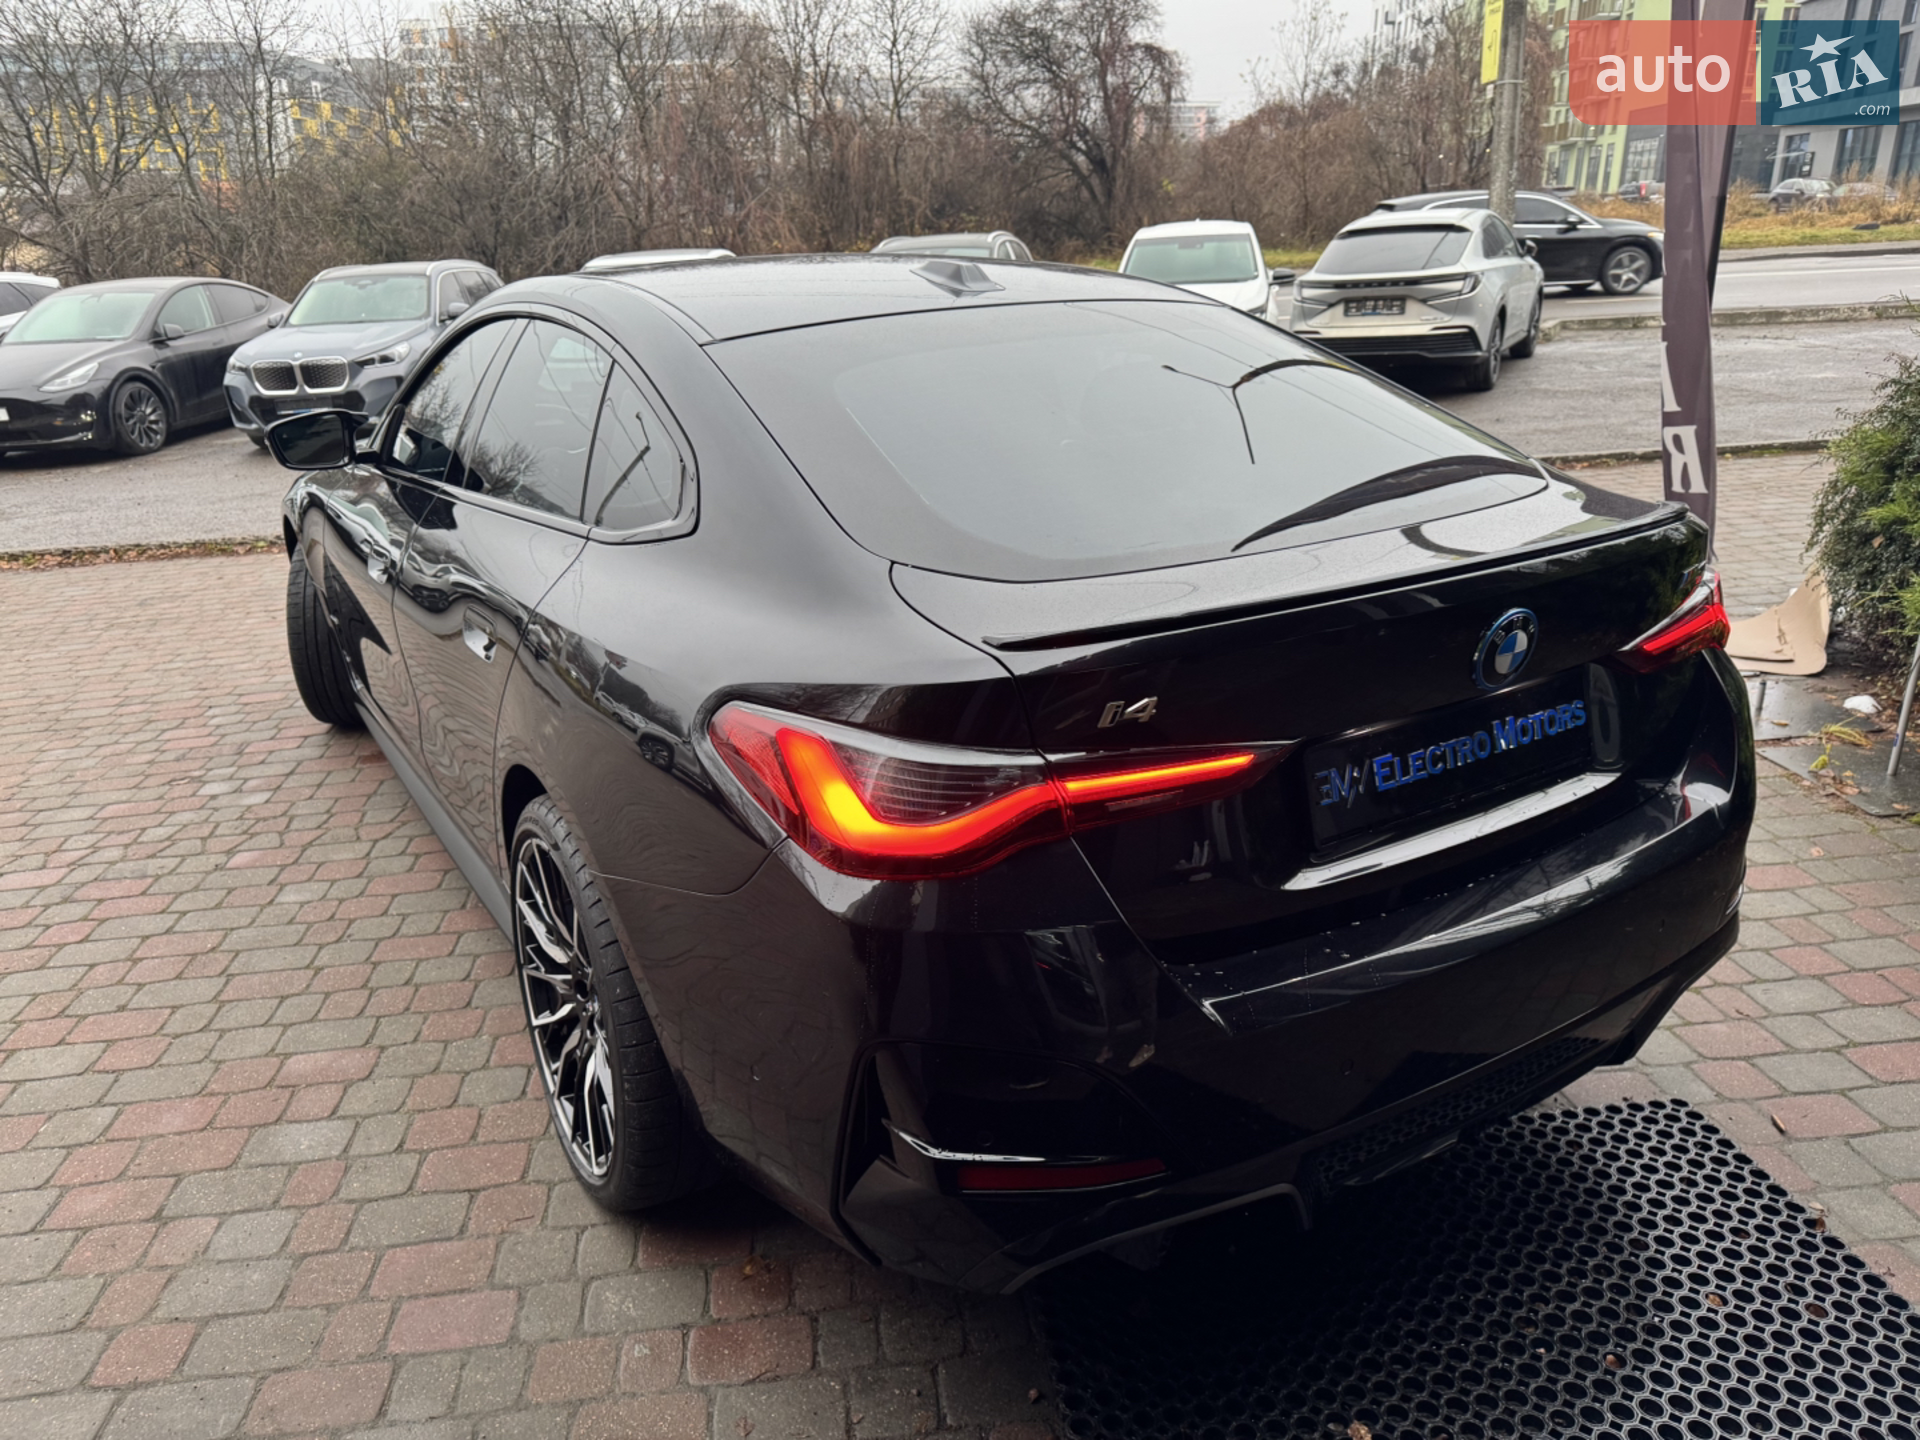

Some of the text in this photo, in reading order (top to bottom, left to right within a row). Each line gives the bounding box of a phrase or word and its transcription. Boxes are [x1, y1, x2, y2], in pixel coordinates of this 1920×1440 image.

[1097, 696, 1158, 728] i4
[1373, 730, 1492, 792] ELECTRO
[1492, 700, 1588, 754] MOTORS
